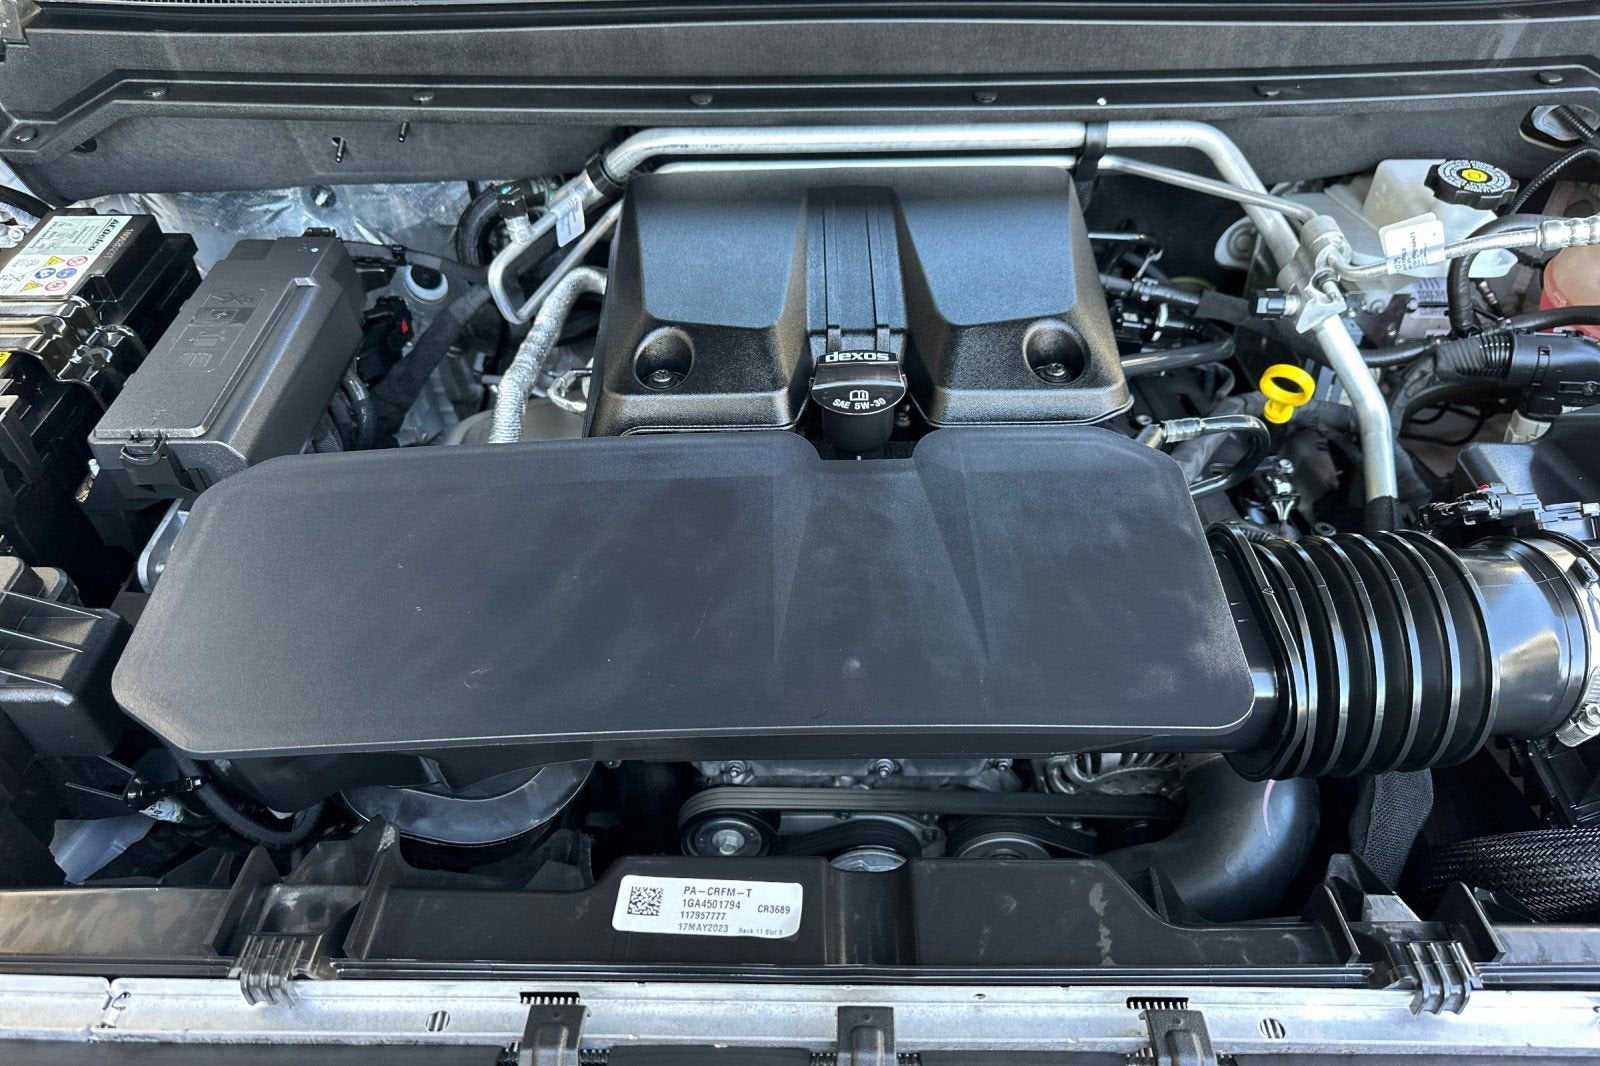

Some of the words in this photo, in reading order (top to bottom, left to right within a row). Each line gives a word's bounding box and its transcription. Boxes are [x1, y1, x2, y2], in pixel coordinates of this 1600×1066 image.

[89, 219, 119, 251] ACDelco
[825, 351, 889, 362] dexos
[832, 398, 851, 410] SAE
[854, 397, 886, 410] 5W-30
[684, 886, 752, 898] PA-CRFM-T
[682, 898, 741, 910] 1GA4501794
[758, 904, 791, 915] CR3689
[680, 911, 726, 921] 117957777
[678, 922, 728, 933] 17MAY2023
